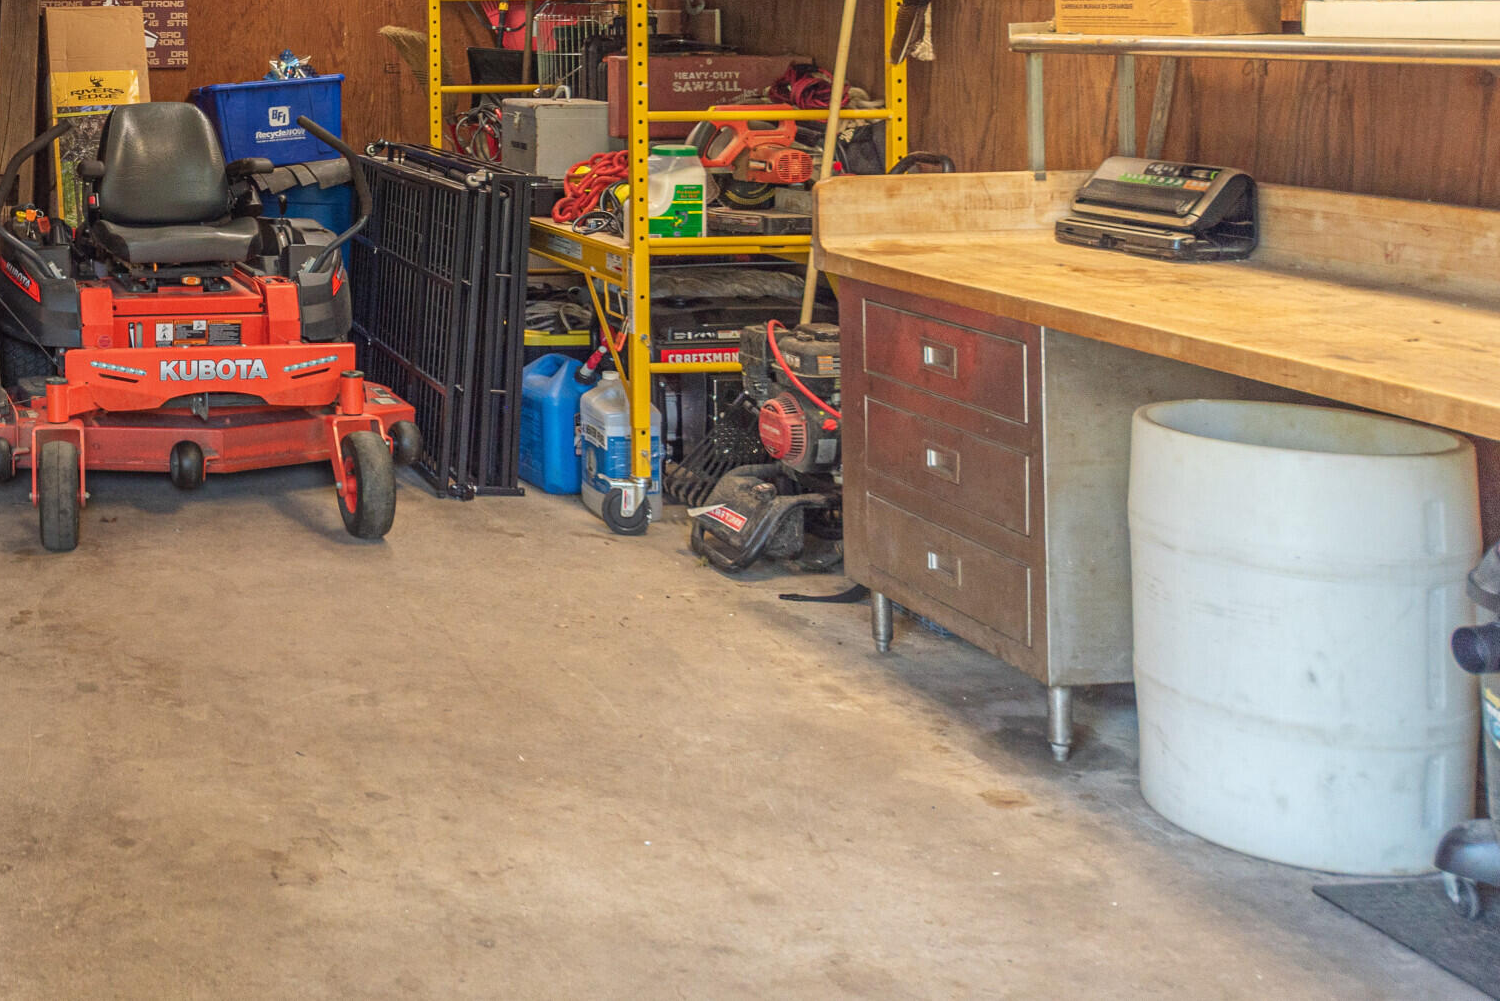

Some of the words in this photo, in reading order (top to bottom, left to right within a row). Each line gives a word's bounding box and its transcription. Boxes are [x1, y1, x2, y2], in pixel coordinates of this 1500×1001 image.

[674, 71, 740, 80] HEAVY-DUTY
[672, 80, 742, 93] SAWZALL
[272, 110, 286, 123] BFI
[6, 262, 30, 288] KUBOTA
[668, 352, 740, 363] CRAFTSMAN
[160, 358, 268, 381] KUBOTA
